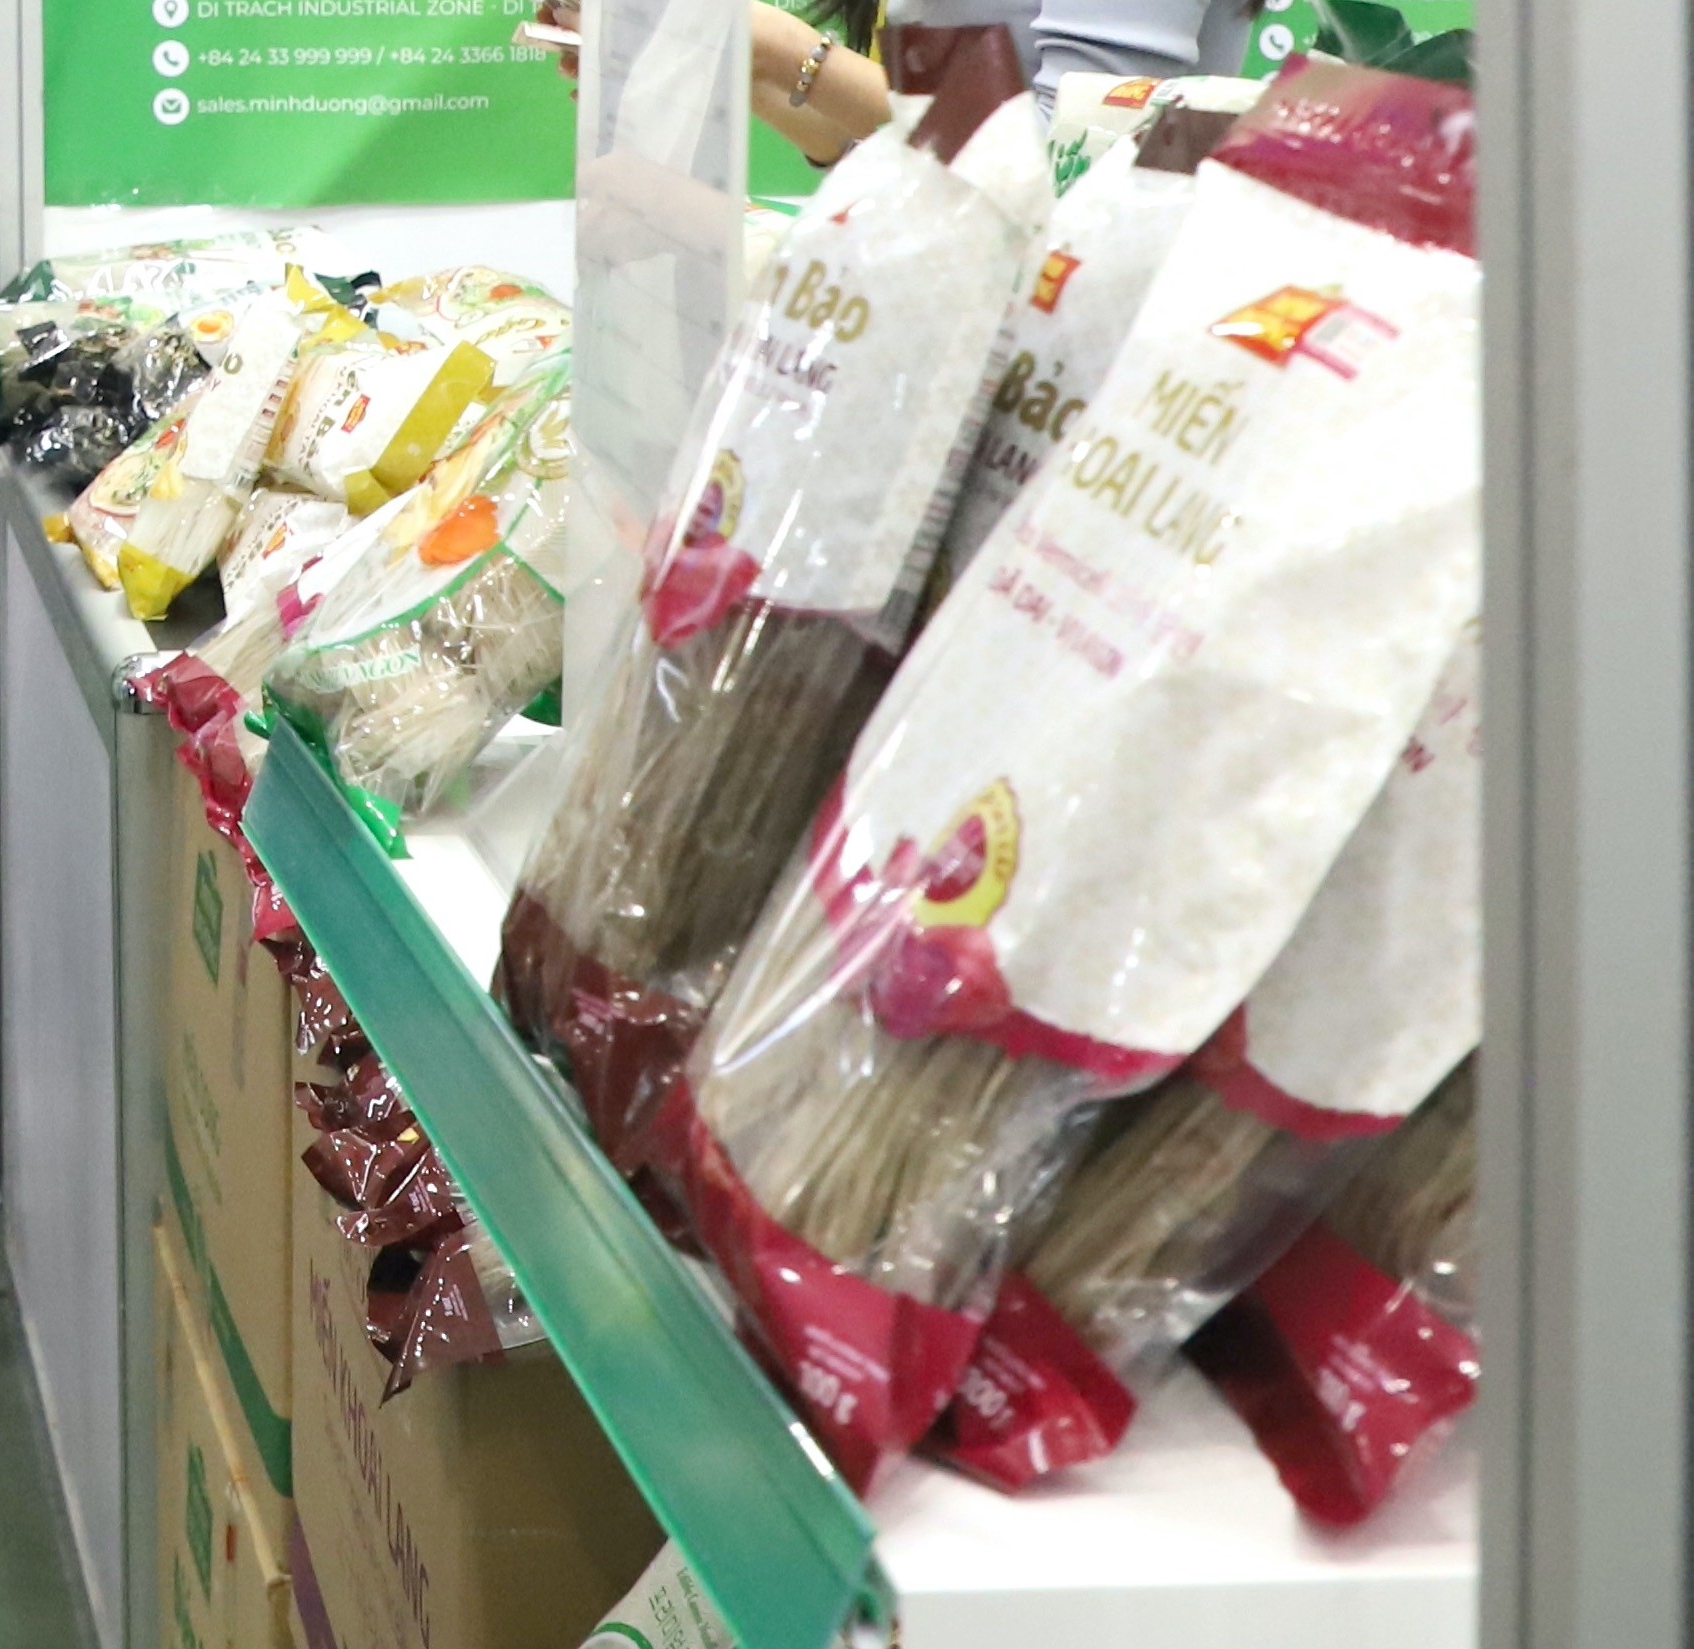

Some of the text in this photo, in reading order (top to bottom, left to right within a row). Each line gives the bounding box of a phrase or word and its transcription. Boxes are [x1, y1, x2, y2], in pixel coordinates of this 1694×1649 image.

[197, 2, 219, 18] DI
[226, 1, 292, 17] TRACH
[298, 0, 421, 16] INDUSTRIAL
[199, 49, 233, 66] +84
[239, 49, 262, 66] 24
[267, 49, 290, 66] 33
[294, 48, 331, 66] 999
[334, 48, 373, 65] 999
[390, 48, 426, 65] +84
[431, 47, 455, 64] 24
[460, 46, 504, 64] 3366
[197, 94, 490, 116] sales.minhduong@gmail.com
[340, 1345, 383, 1521] KHOAI
[386, 1471, 430, 1649] LANG
